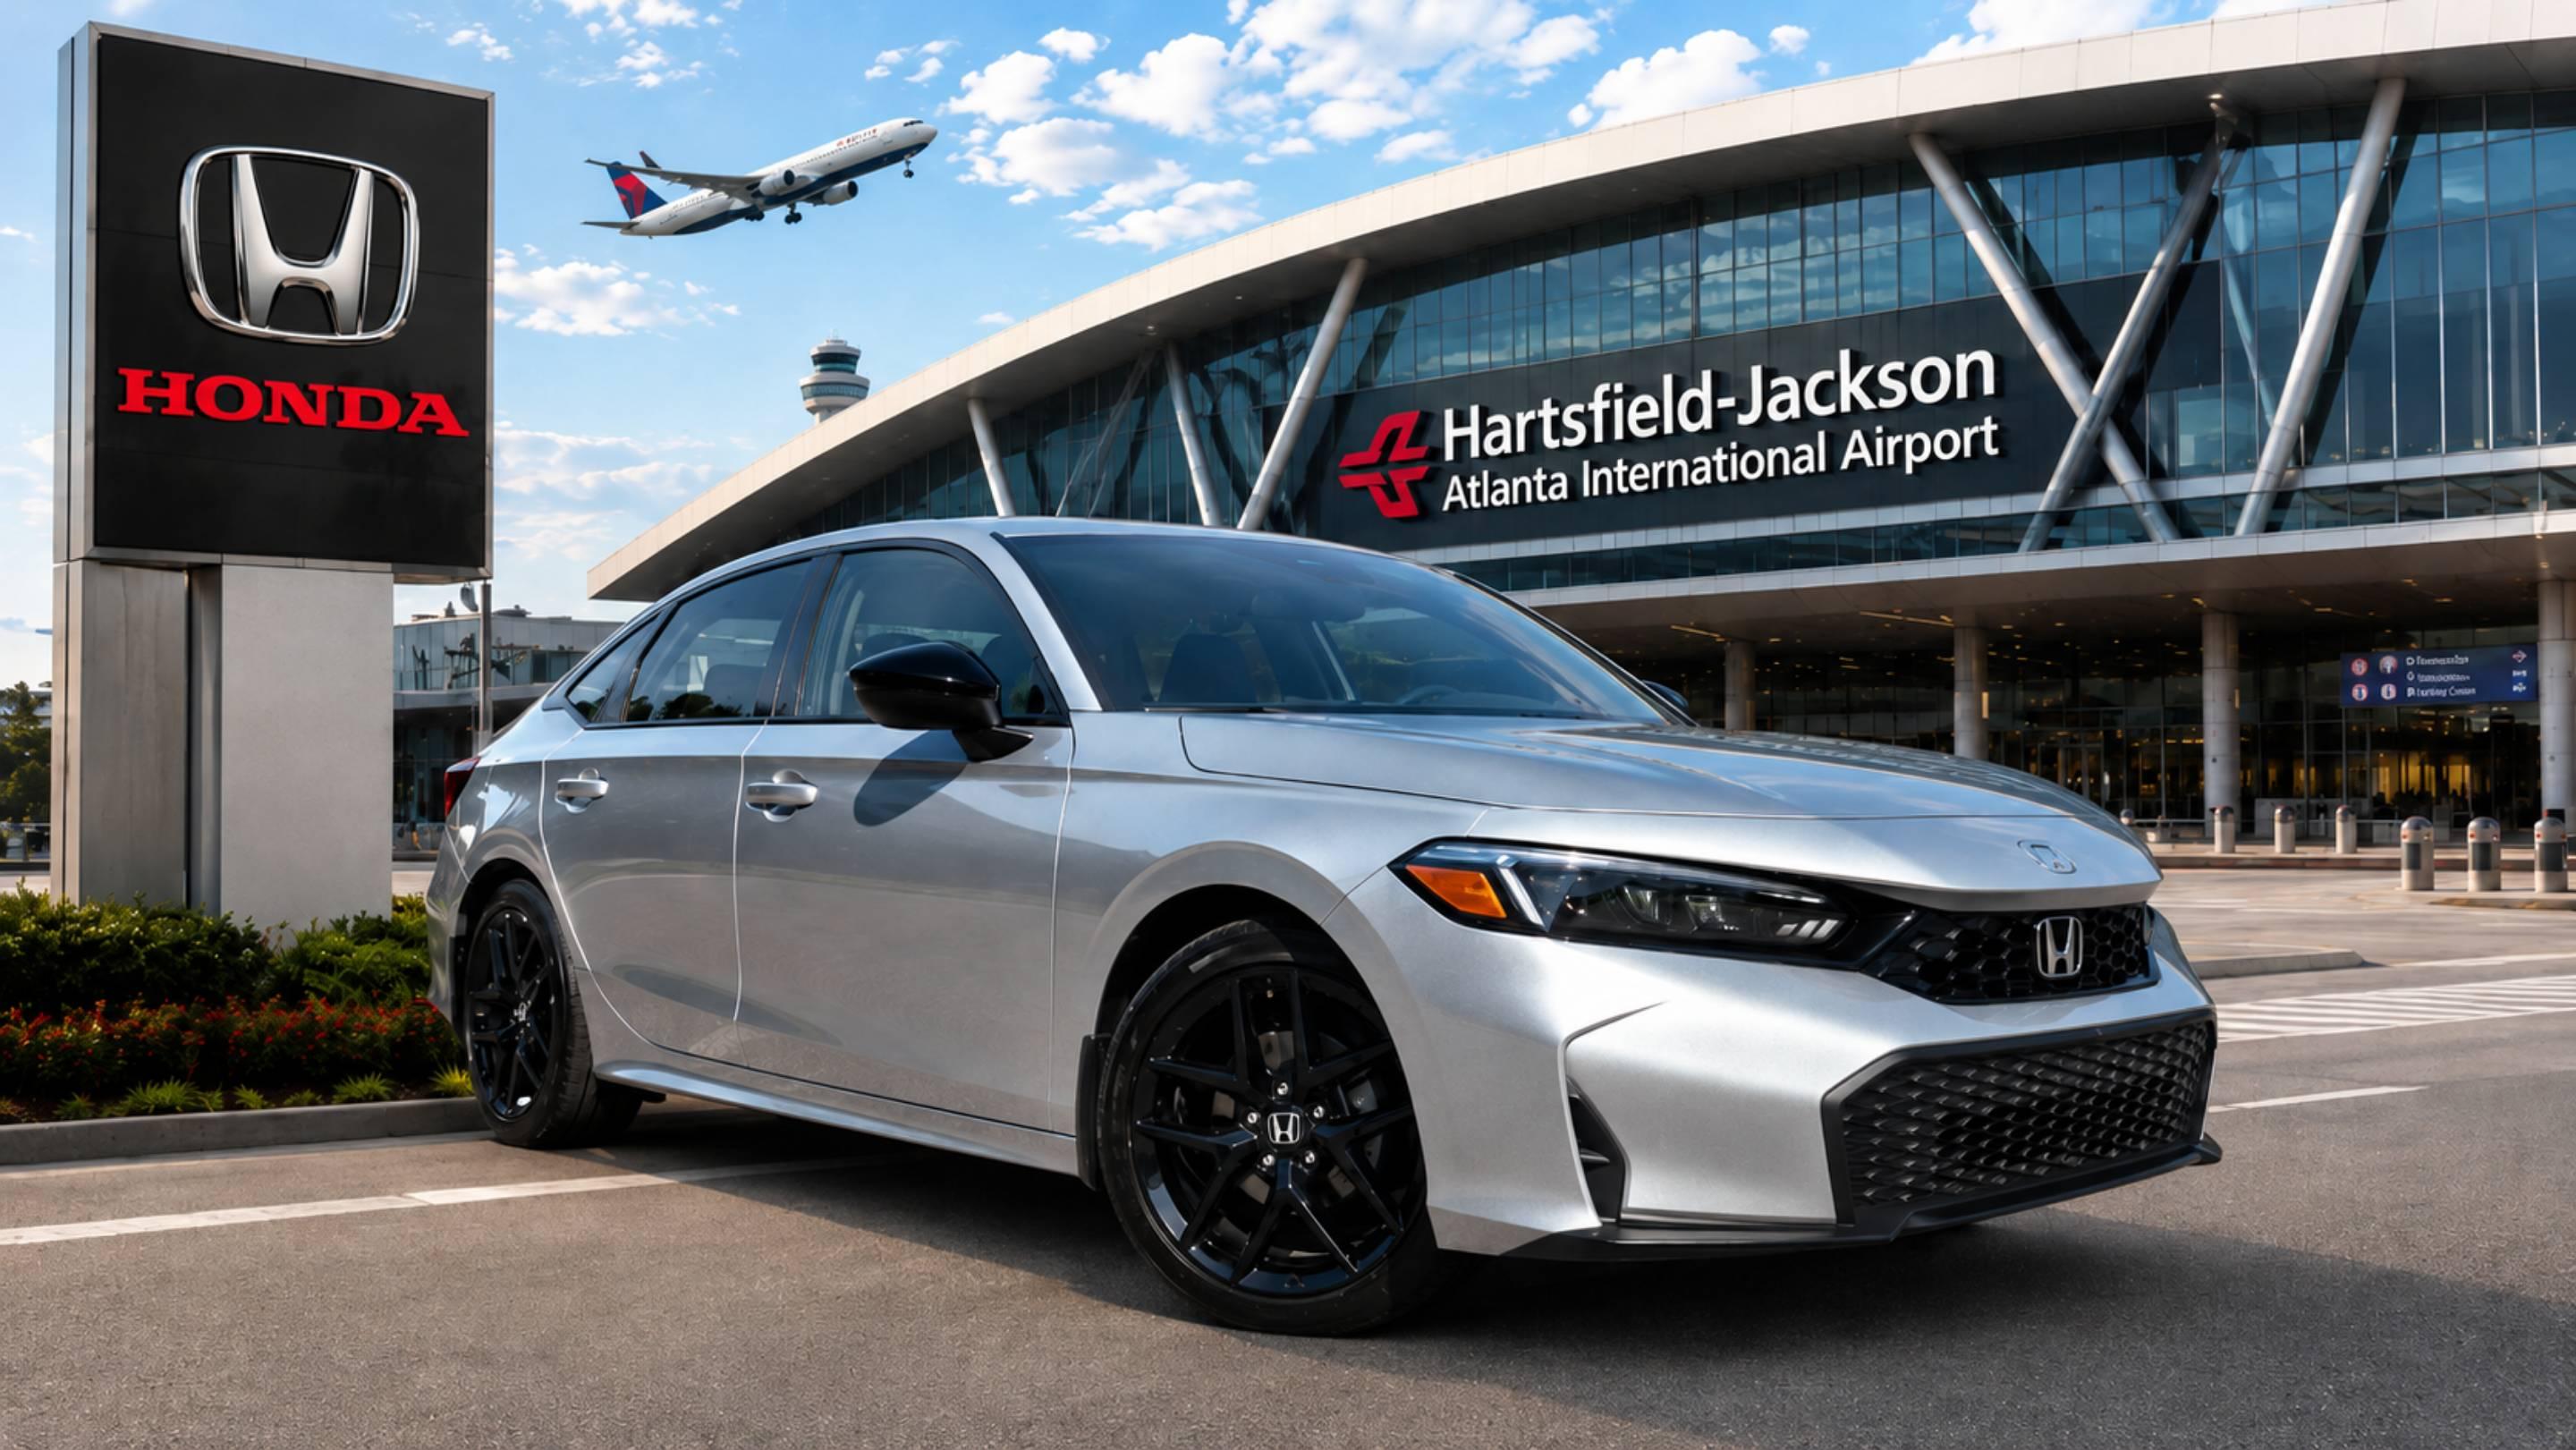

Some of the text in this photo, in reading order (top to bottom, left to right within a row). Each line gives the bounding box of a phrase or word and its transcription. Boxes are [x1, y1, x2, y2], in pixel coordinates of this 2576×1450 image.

[118, 368, 470, 437] HONDA
[1444, 348, 1996, 462] Hartsfield-Jackson
[1443, 415, 2000, 511] Atlanta International Airport
